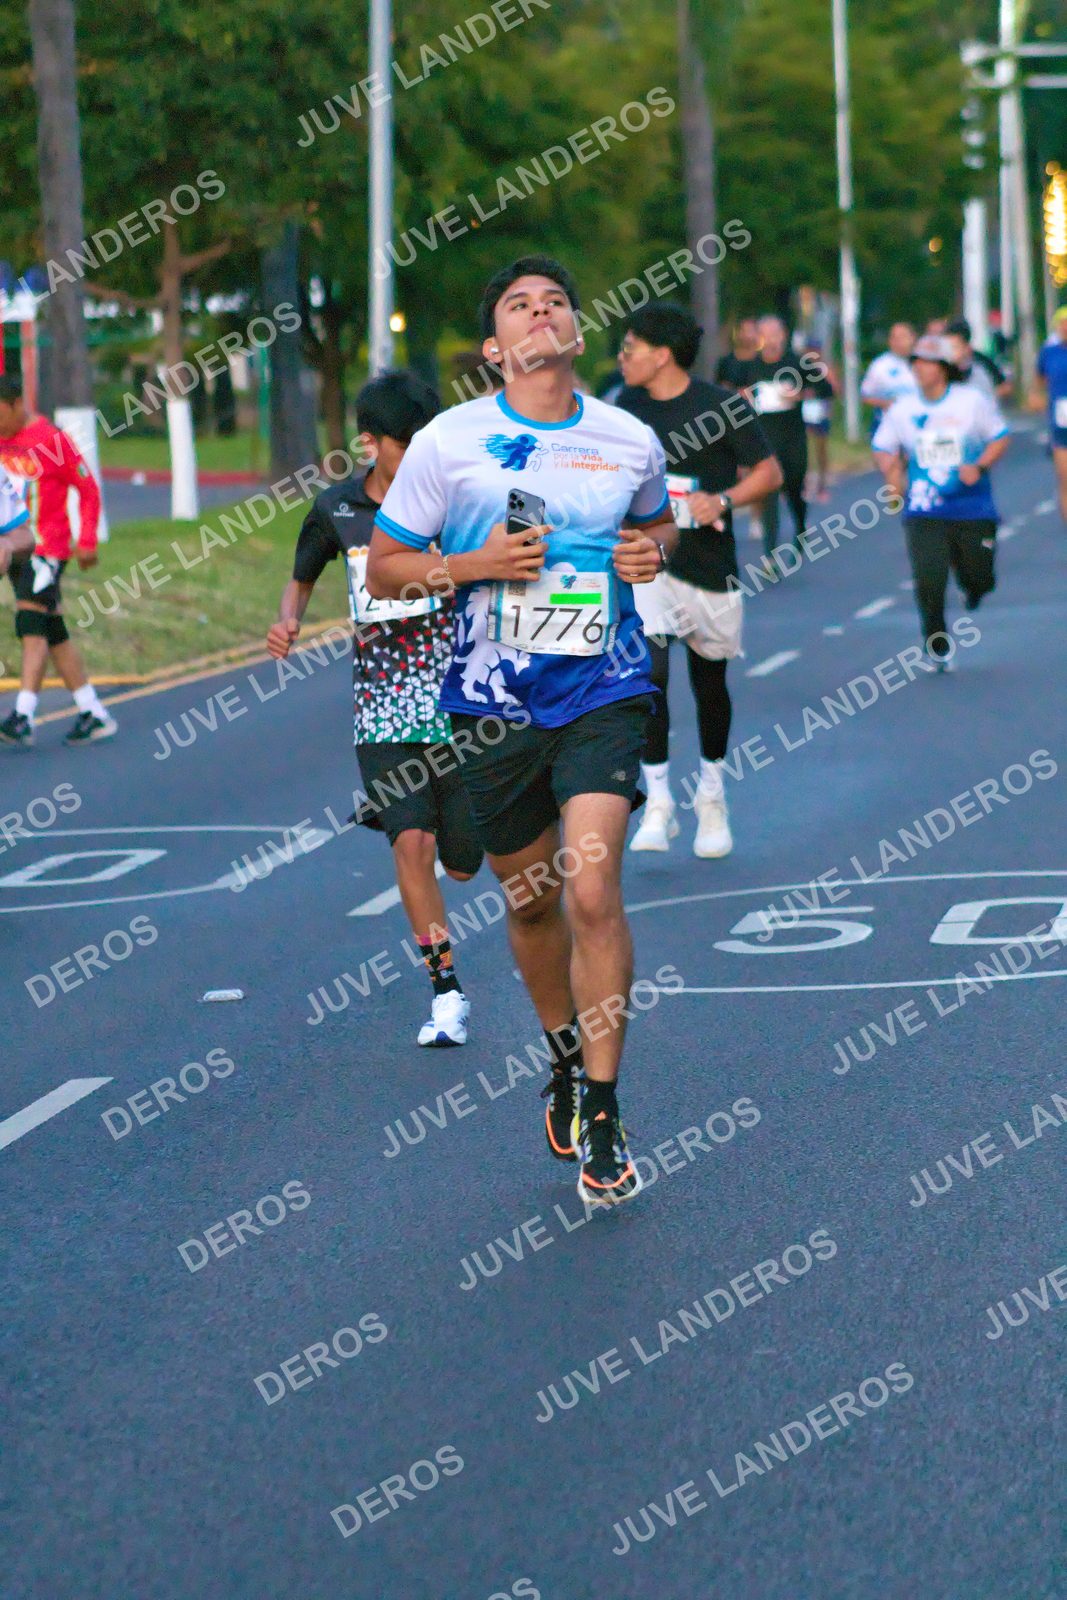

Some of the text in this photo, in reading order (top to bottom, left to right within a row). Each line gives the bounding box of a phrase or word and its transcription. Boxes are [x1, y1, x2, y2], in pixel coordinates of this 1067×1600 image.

[551, 443, 599, 455] Carrera
[581, 454, 603, 462] Vida
[571, 460, 620, 472] Integridad
[511, 605, 603, 644] 1776
